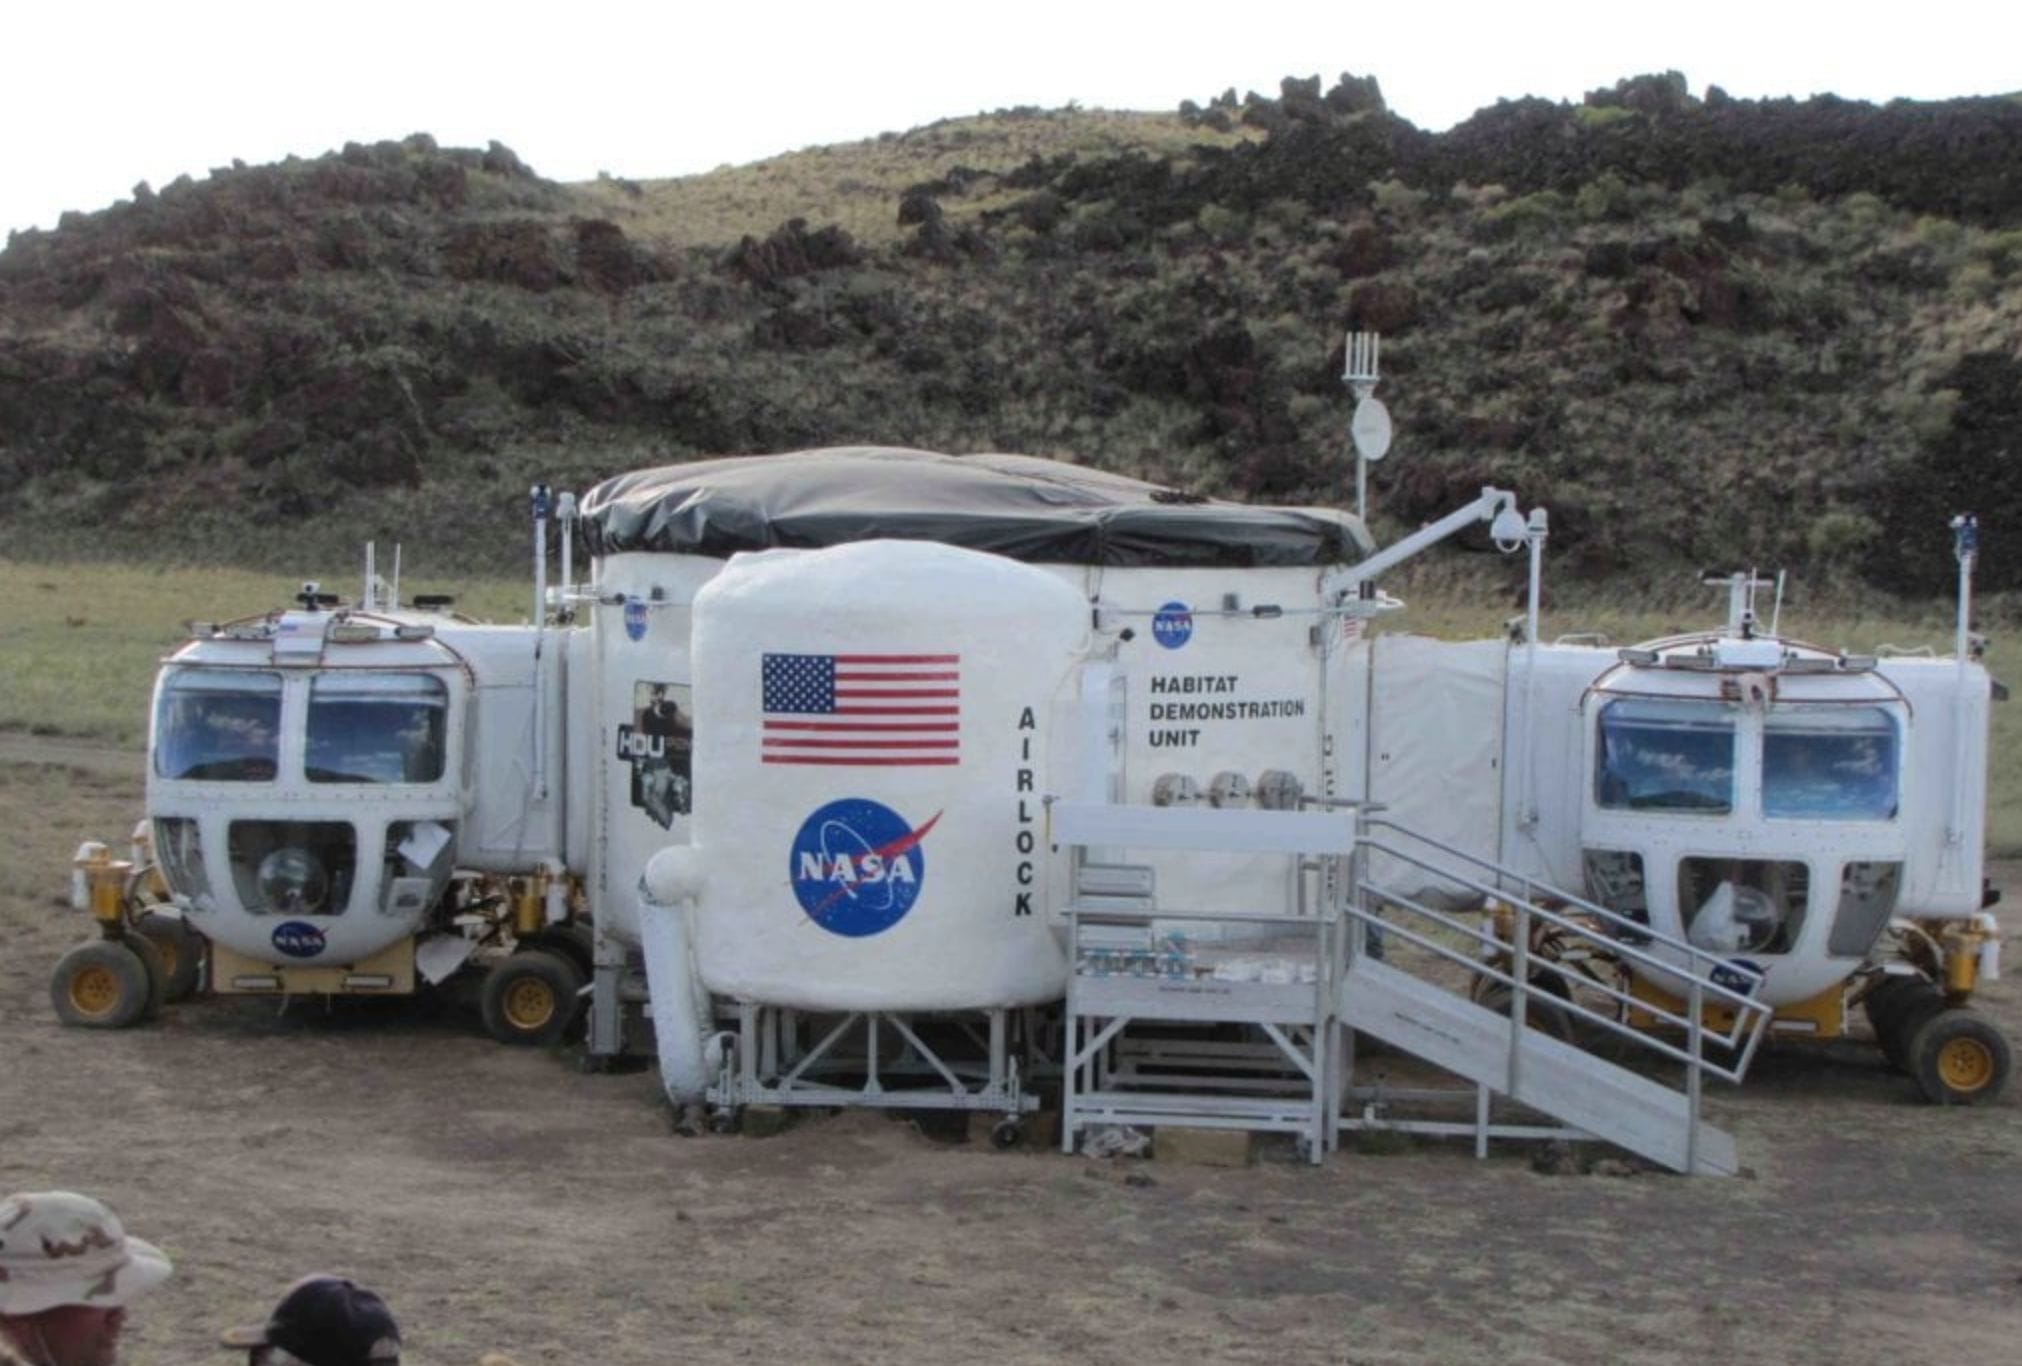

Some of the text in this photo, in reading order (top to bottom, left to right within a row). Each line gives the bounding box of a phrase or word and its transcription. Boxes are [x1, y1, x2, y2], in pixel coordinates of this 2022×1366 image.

[1155, 619, 1190, 632] NASA
[1151, 676, 1238, 693] HABITAT
[1150, 700, 1305, 720] DEMONSTRATION
[620, 732, 665, 758] HDU
[1149, 730, 1200, 747] UNIT
[1015, 706, 1035, 916] AIRLOCK
[799, 852, 916, 883] NASA
